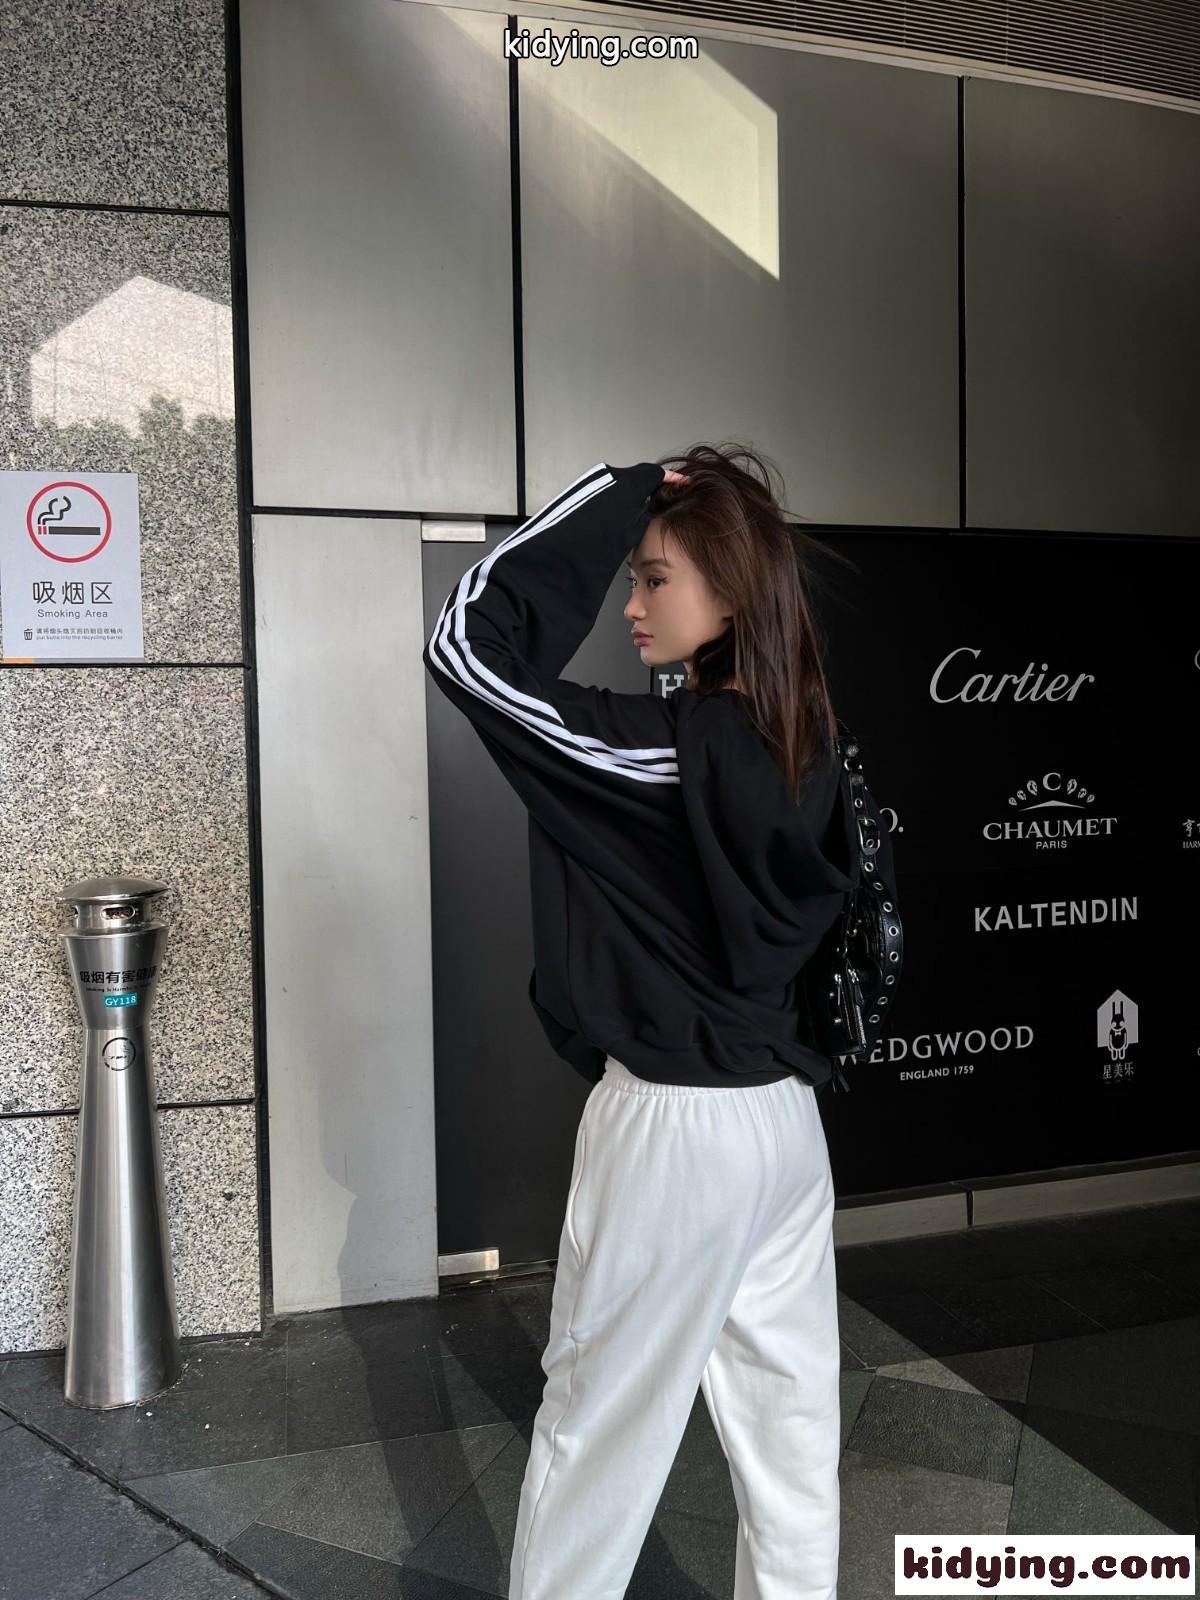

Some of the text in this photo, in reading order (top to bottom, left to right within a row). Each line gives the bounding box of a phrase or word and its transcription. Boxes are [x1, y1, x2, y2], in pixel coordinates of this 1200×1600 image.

[33, 581, 112, 604] 吸烟区
[38, 609, 108, 619] Smoking Area
[929, 647, 1095, 703] Cartier
[1042, 772, 1062, 791] C
[982, 817, 1118, 841] CHAUMET
[1035, 840, 1068, 850] PARIS
[974, 896, 1138, 932] KALTENDIN
[104, 995, 136, 1007] GY118
[899, 1064, 974, 1080] ENGLAND 1759
[1102, 1061, 1135, 1080] 星美乐
